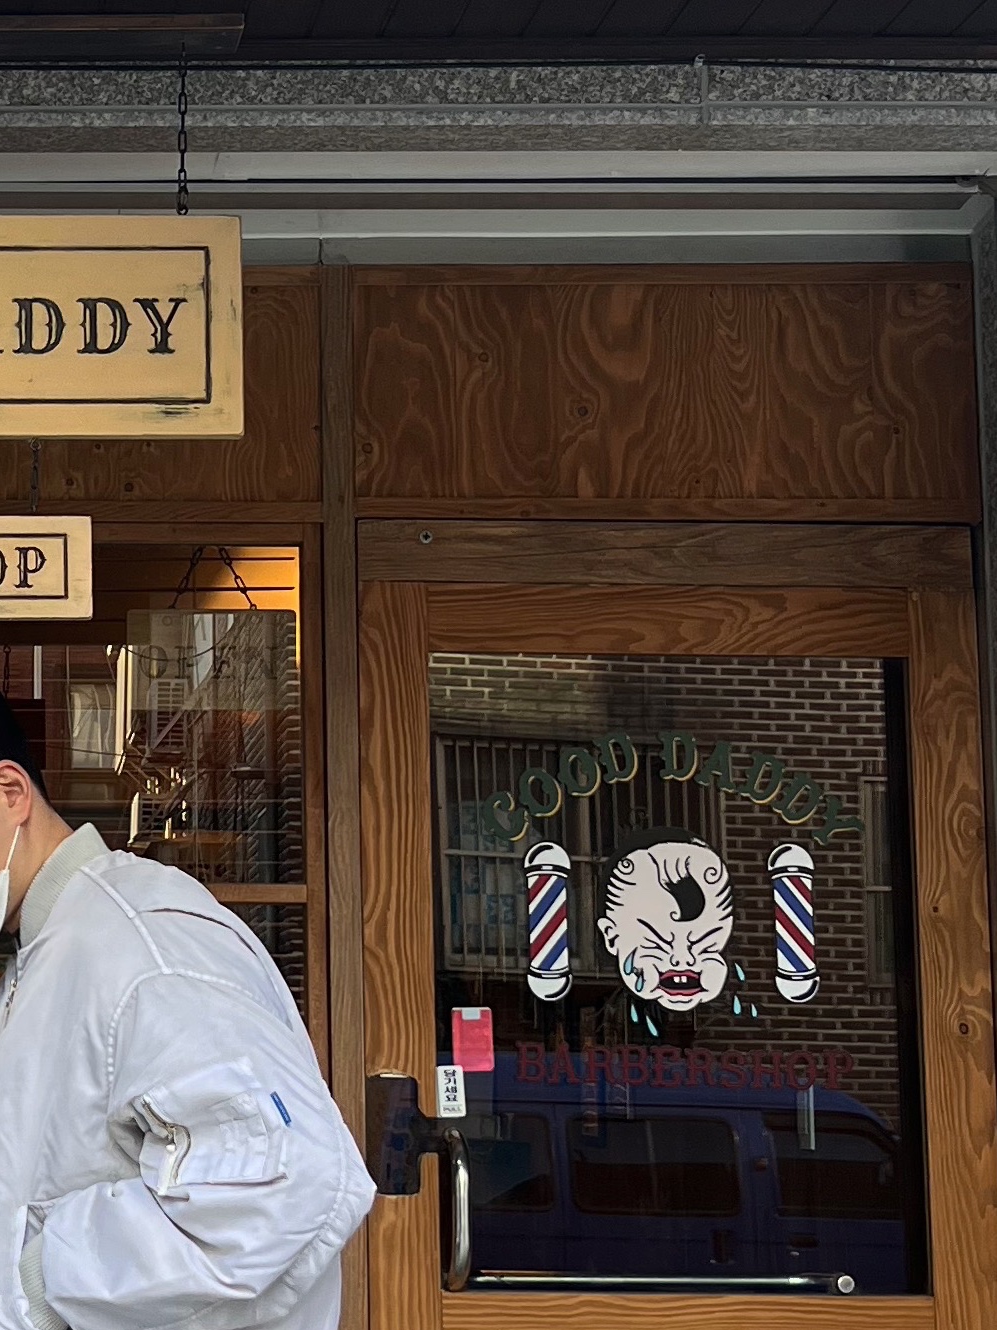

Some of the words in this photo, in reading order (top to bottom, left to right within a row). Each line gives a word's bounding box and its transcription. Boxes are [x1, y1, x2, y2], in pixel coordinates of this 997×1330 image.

[482, 729, 639, 842] GOOD
[659, 730, 864, 845] DADDY
[443, 1069, 458, 1102] 당기세요
[515, 1041, 853, 1090] BARBERSHOP
